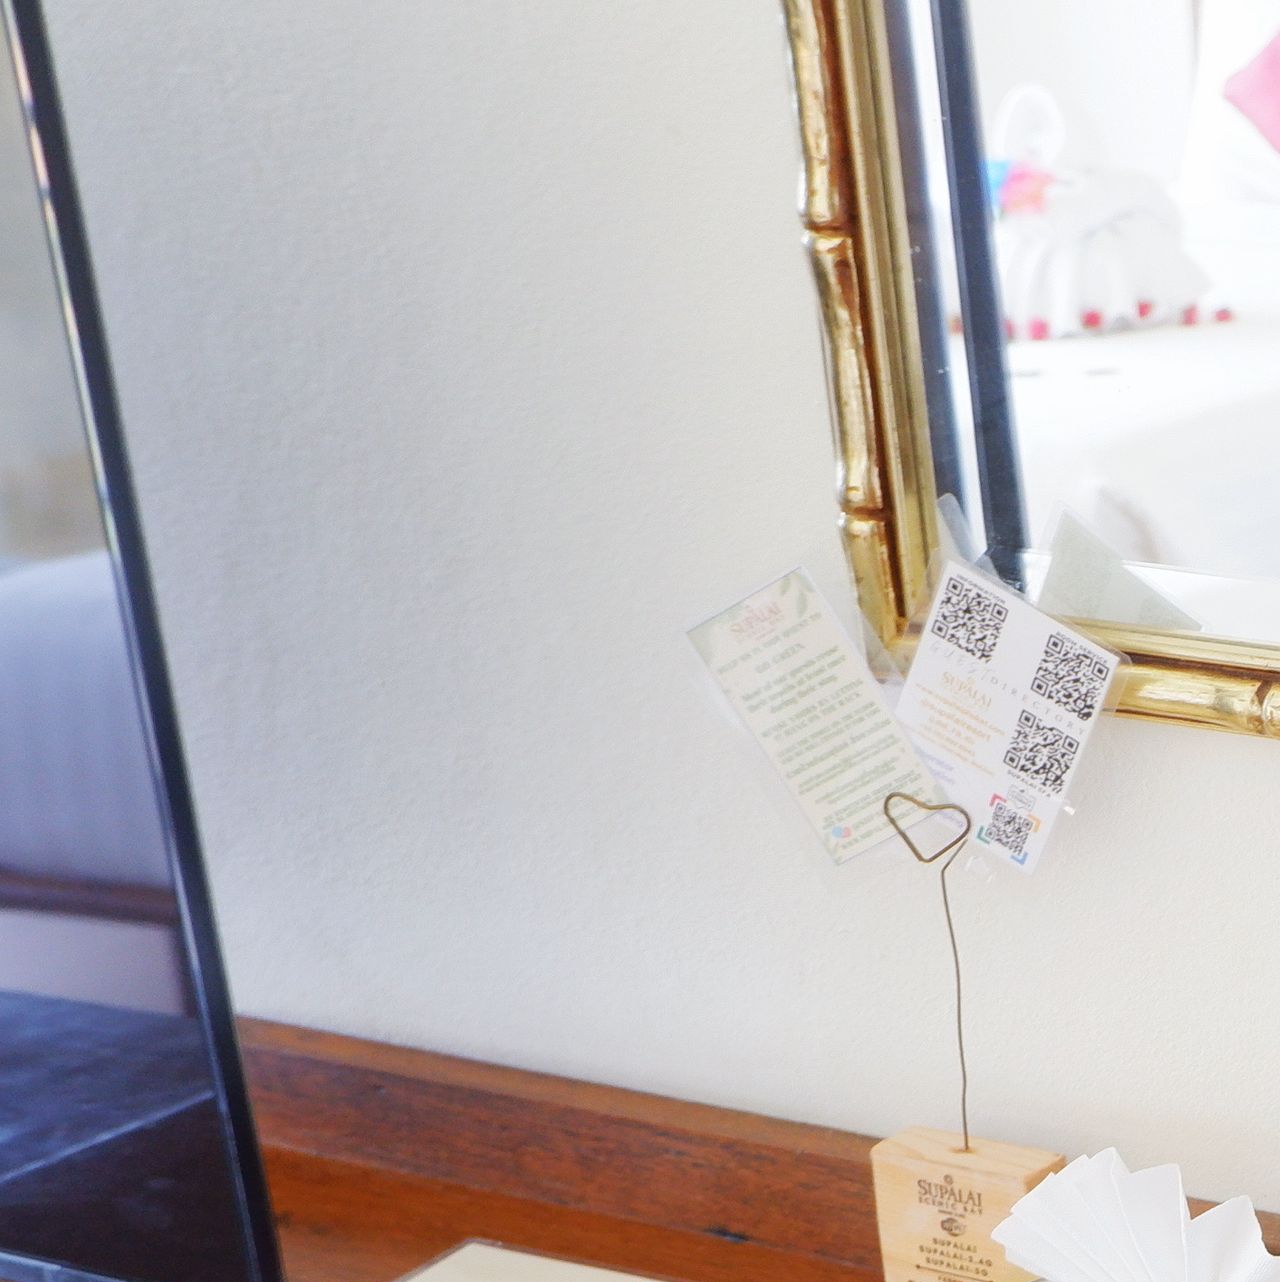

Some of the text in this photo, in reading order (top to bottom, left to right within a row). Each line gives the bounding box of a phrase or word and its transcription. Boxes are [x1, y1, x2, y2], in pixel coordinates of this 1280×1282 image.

[1056, 631, 1108, 664] ROOM SERVICE
[991, 677, 1085, 735] DIRECTORY
[917, 1179, 983, 1207] SUPALAI
[932, 1238, 977, 1253] SUPALAI
